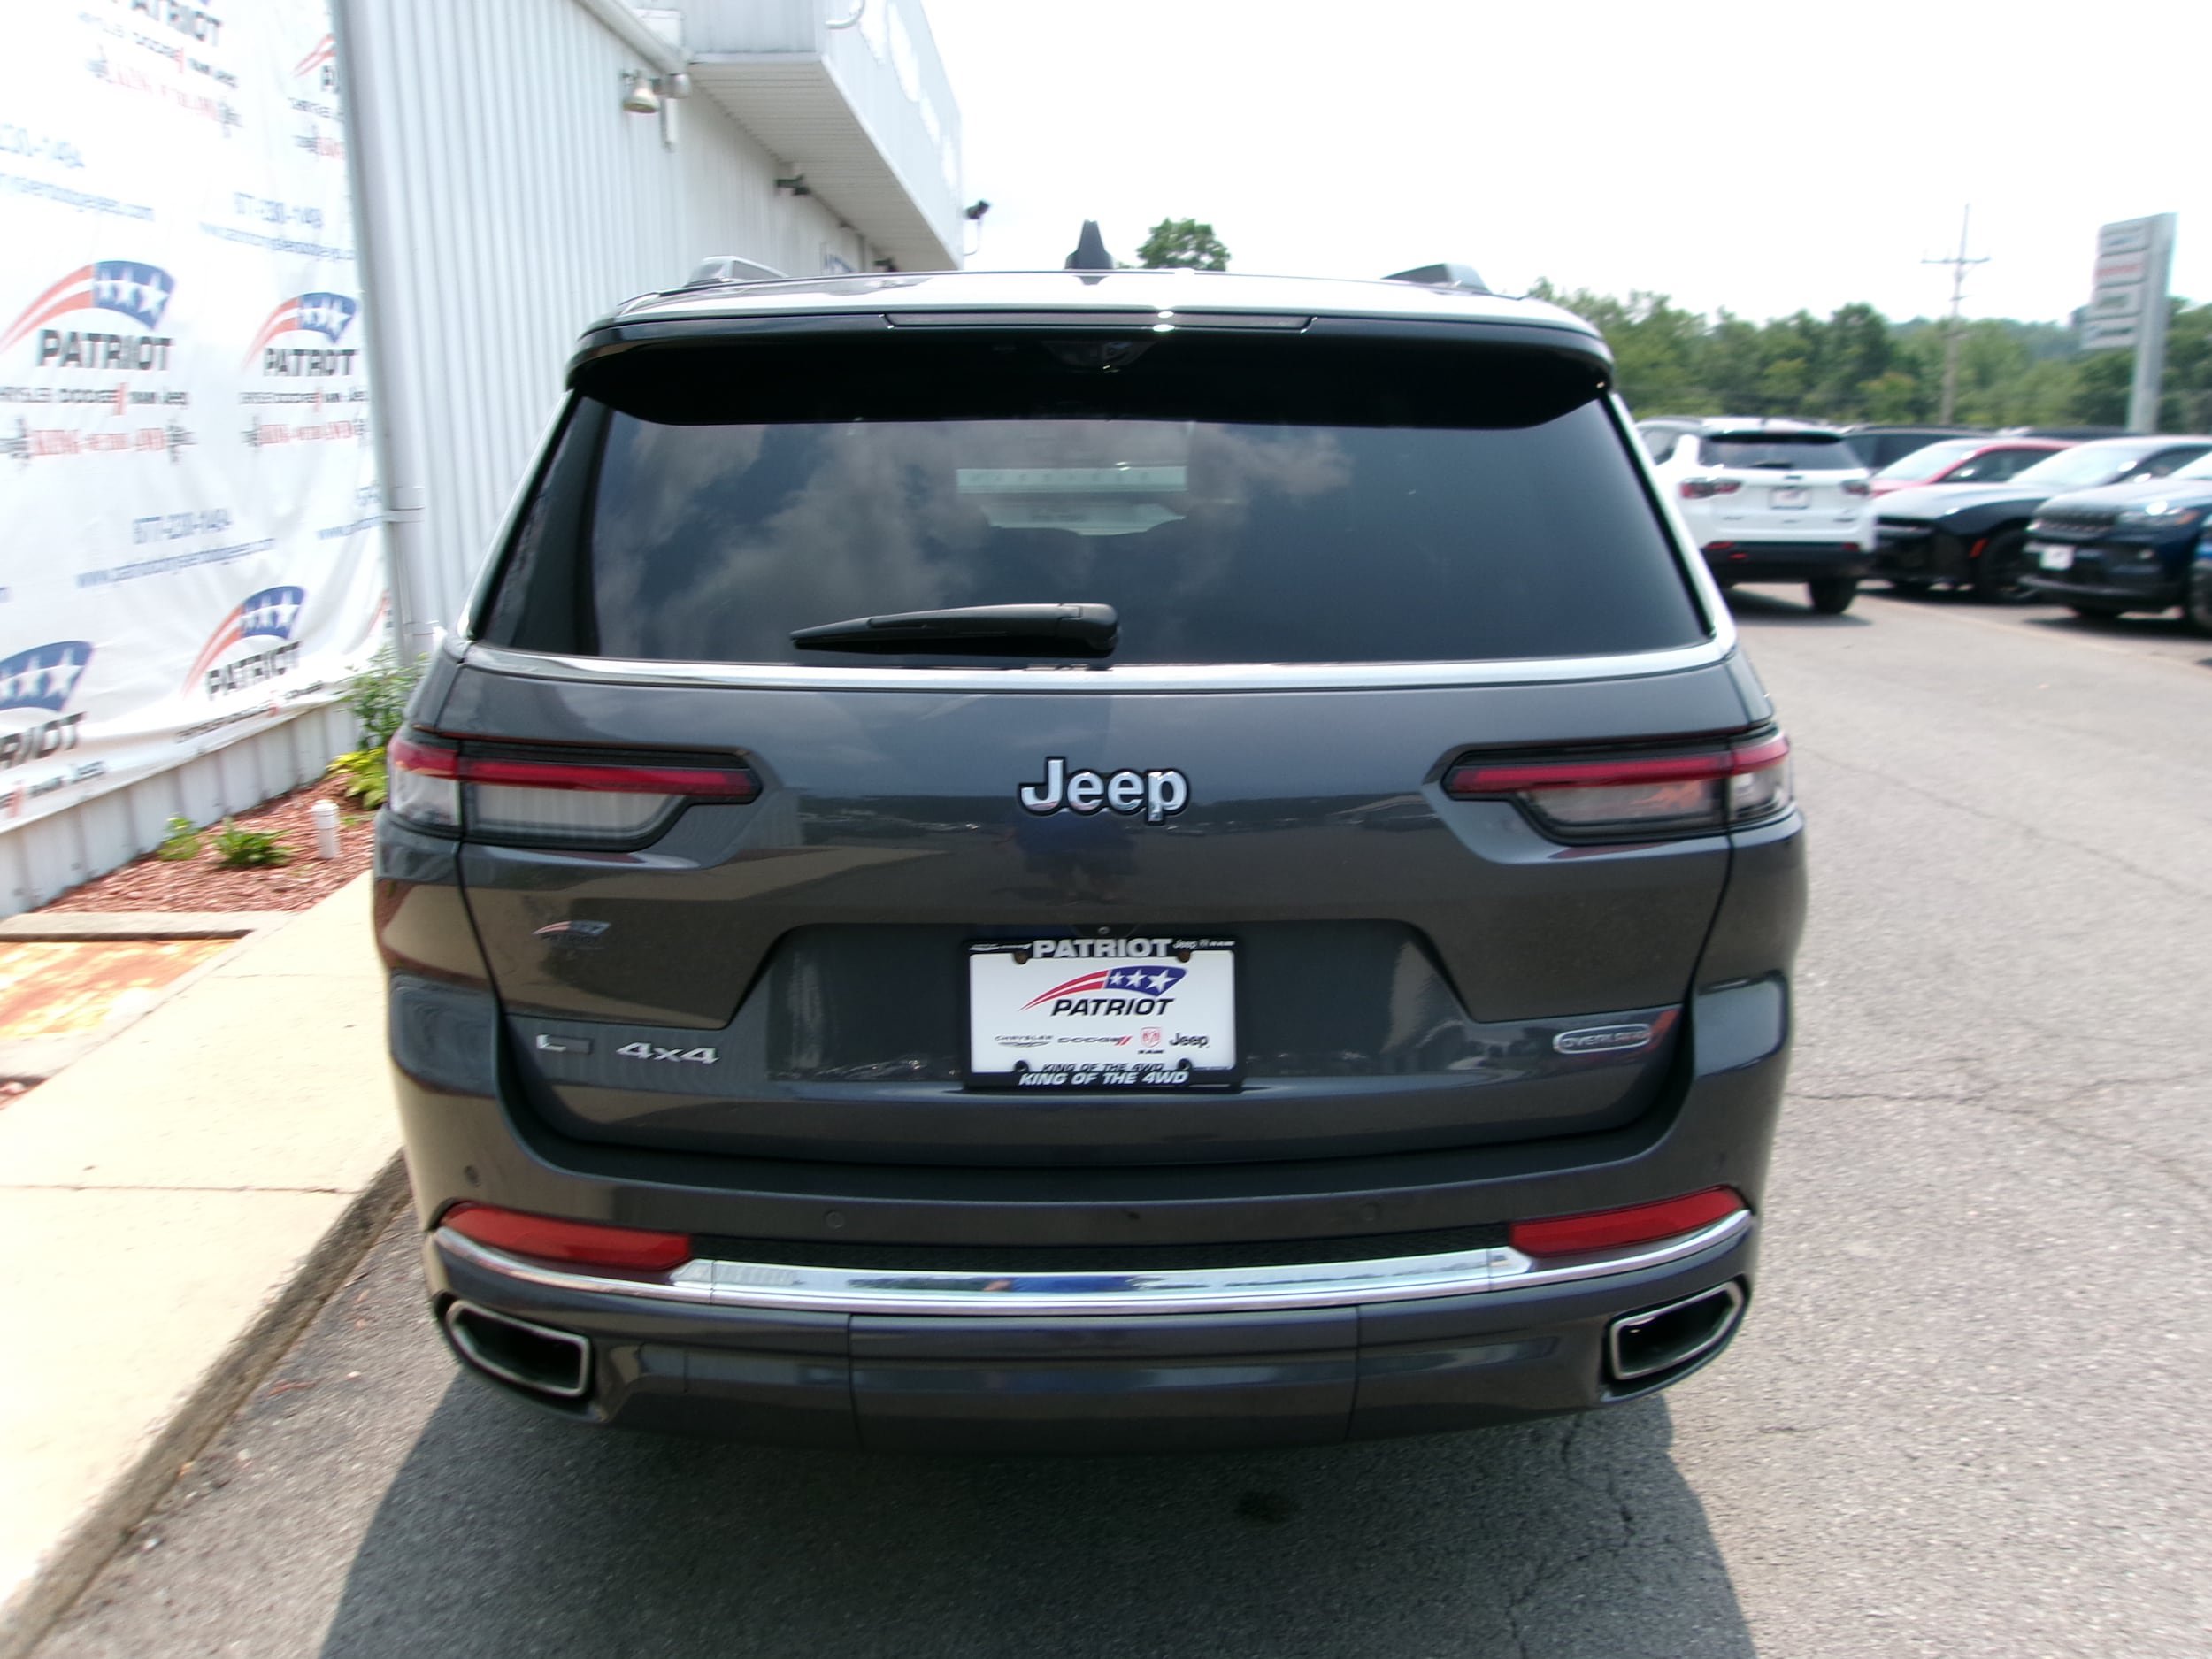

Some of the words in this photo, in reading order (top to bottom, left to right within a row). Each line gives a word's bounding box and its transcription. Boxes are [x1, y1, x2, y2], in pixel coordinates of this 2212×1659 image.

[37, 328, 174, 371] PATRIOT
[1018, 756, 1189, 825] Jeep
[1032, 938, 1172, 958] PATRIOT
[1051, 997, 1176, 1017] PATRIOT
[1168, 1032, 1210, 1048] Jeep
[616, 1041, 721, 1065] 4x4
[1018, 1071, 1069, 1086] KING
[1071, 1071, 1099, 1085] OF
[1102, 1071, 1138, 1085] THE
[1141, 1071, 1190, 1084] 4WD
